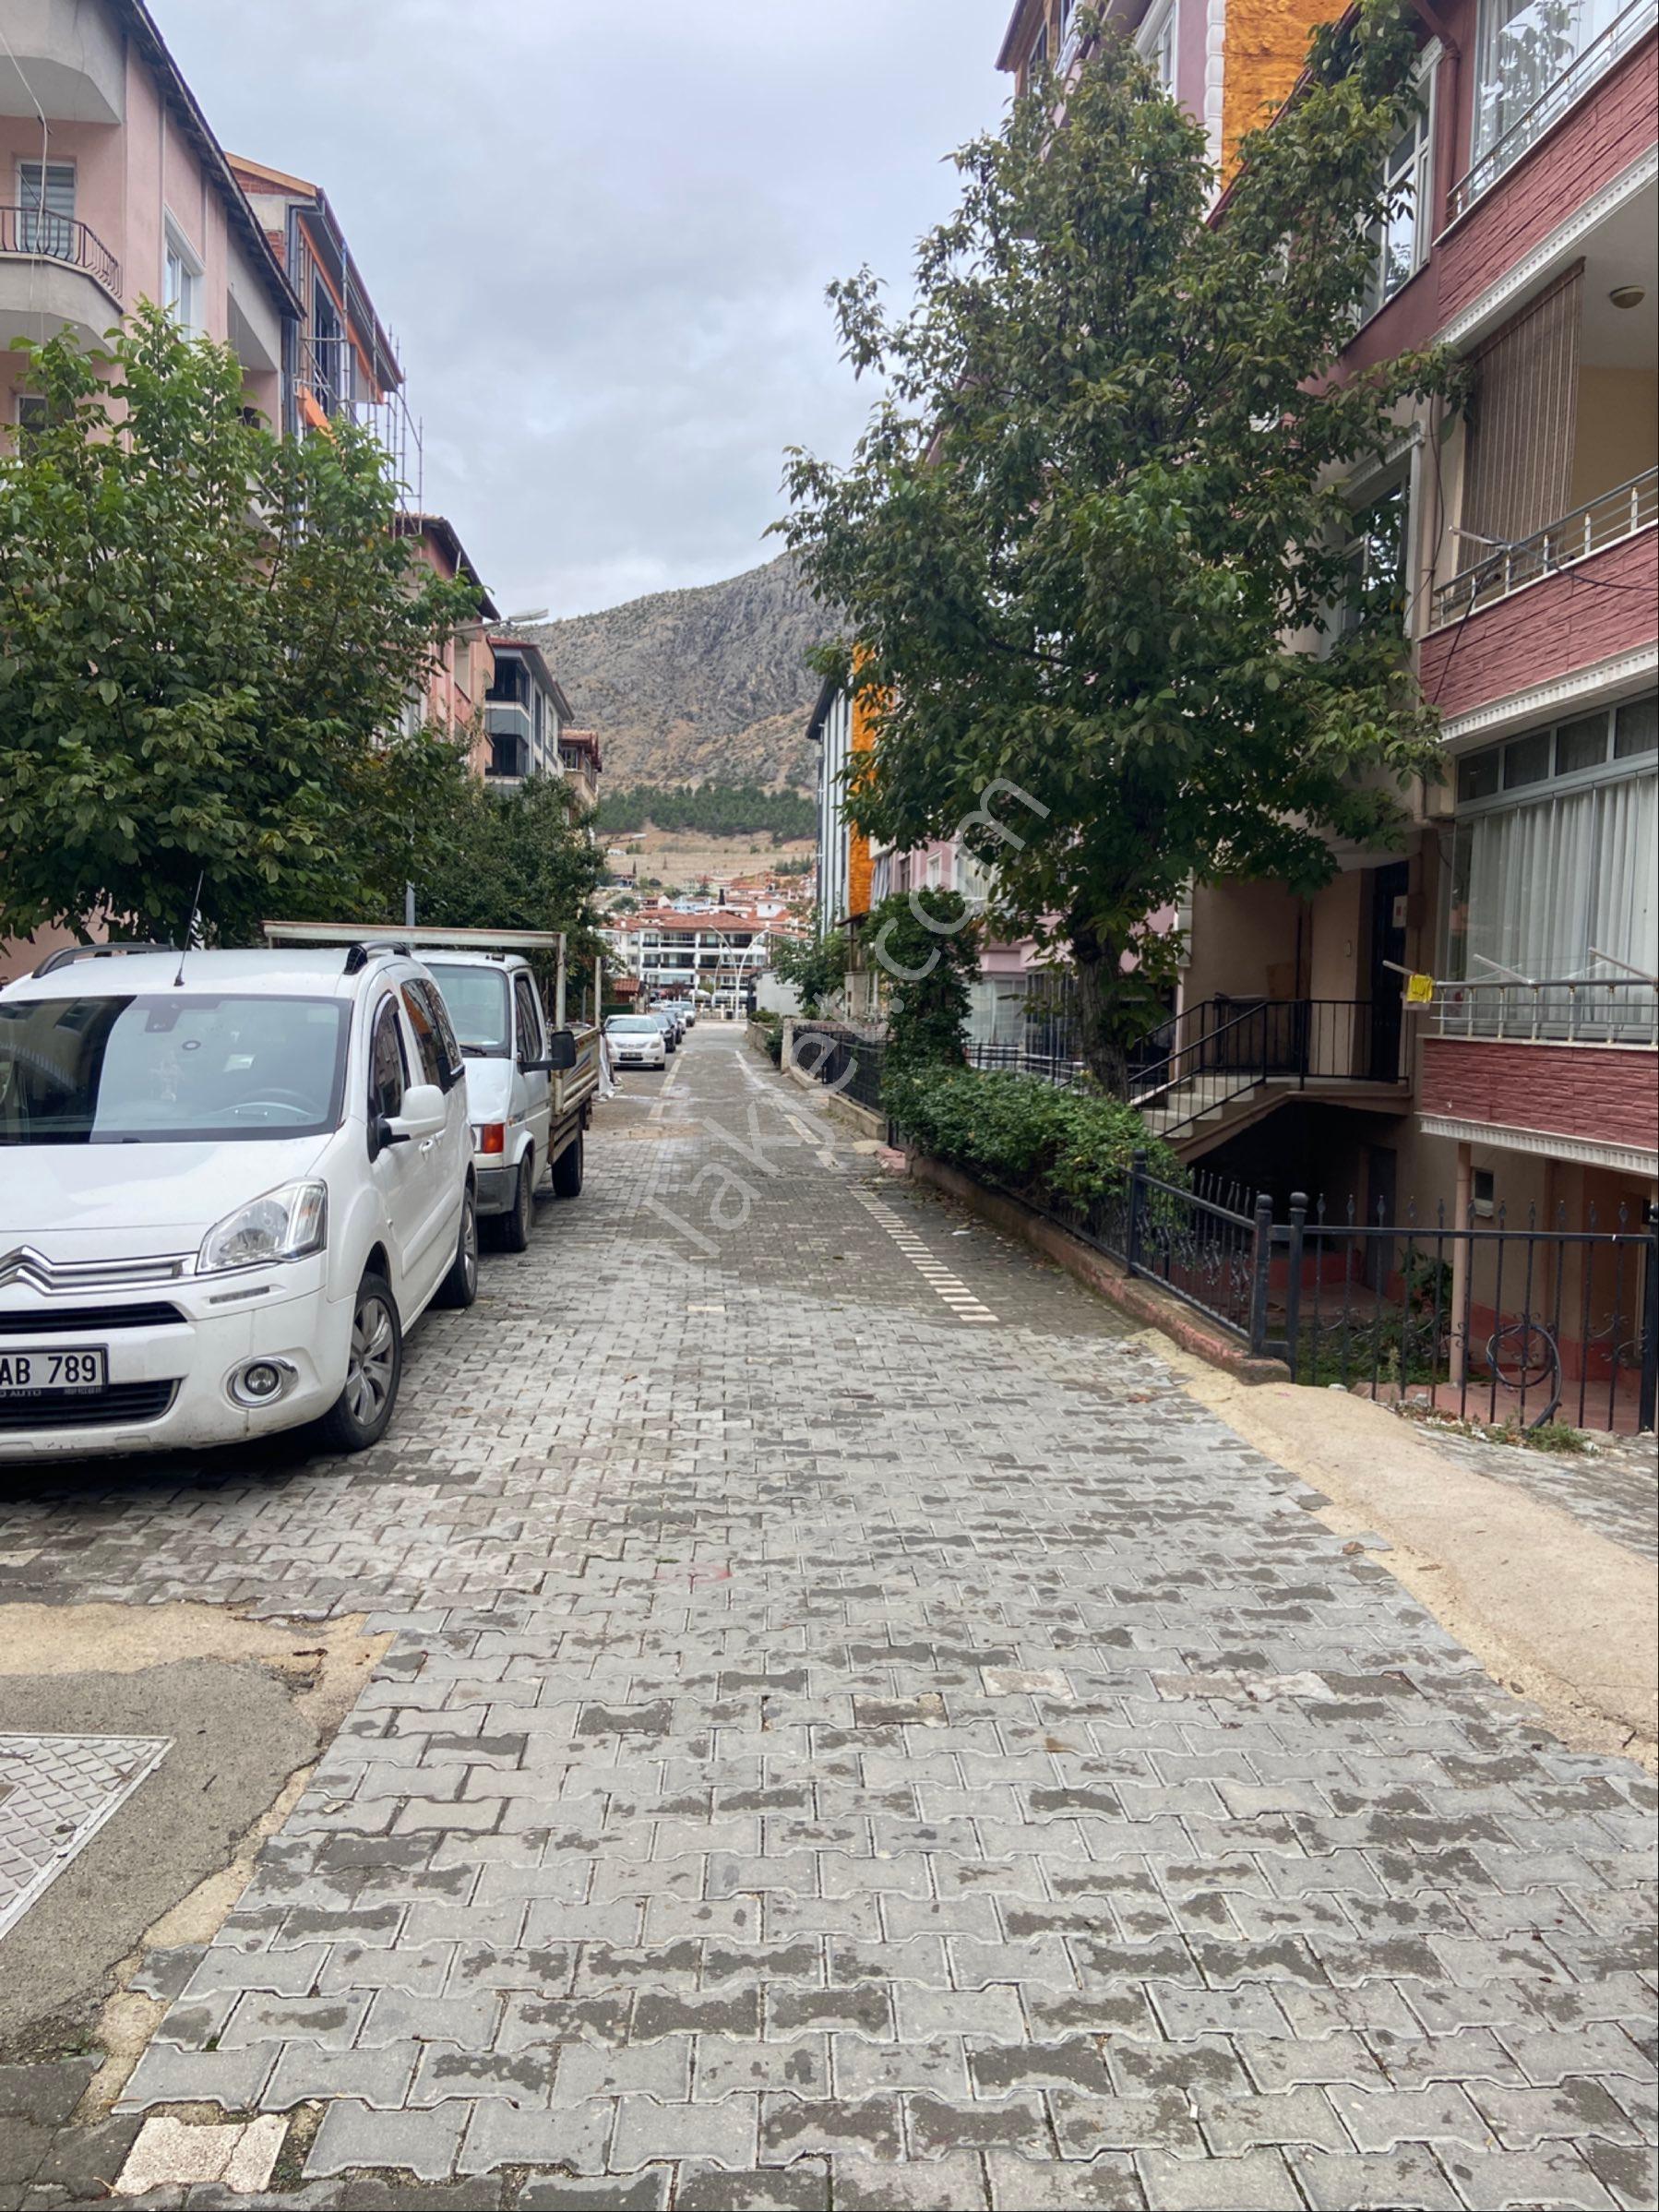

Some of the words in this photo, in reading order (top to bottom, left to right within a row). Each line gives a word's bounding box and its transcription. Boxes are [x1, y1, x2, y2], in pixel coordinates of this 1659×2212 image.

[0, 1357, 30, 1385] AB
[47, 1355, 96, 1383] 789
[9, 1389, 42, 1397] AUTO
